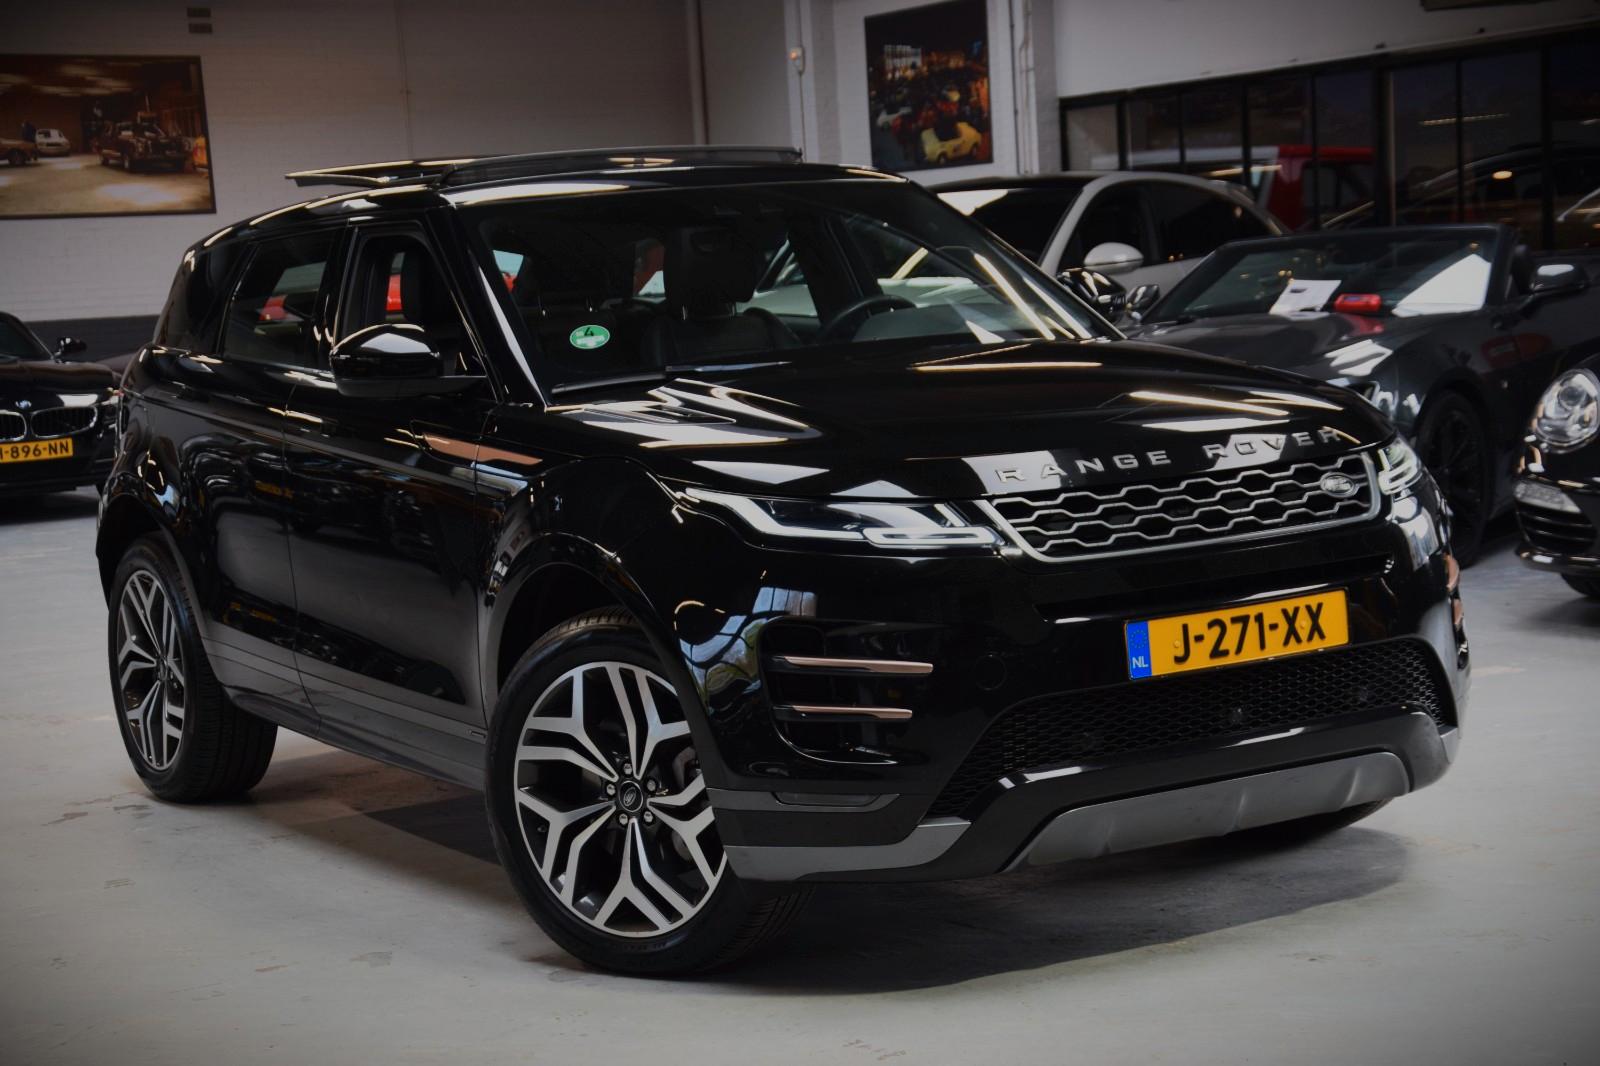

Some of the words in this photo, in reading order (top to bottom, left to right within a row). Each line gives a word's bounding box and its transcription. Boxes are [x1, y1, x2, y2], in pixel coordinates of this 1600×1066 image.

[994, 450, 1172, 484] RANGE
[1202, 428, 1341, 459] ROVER
[1173, 602, 1326, 665] J-271-XX
[1132, 656, 1149, 669] NL
